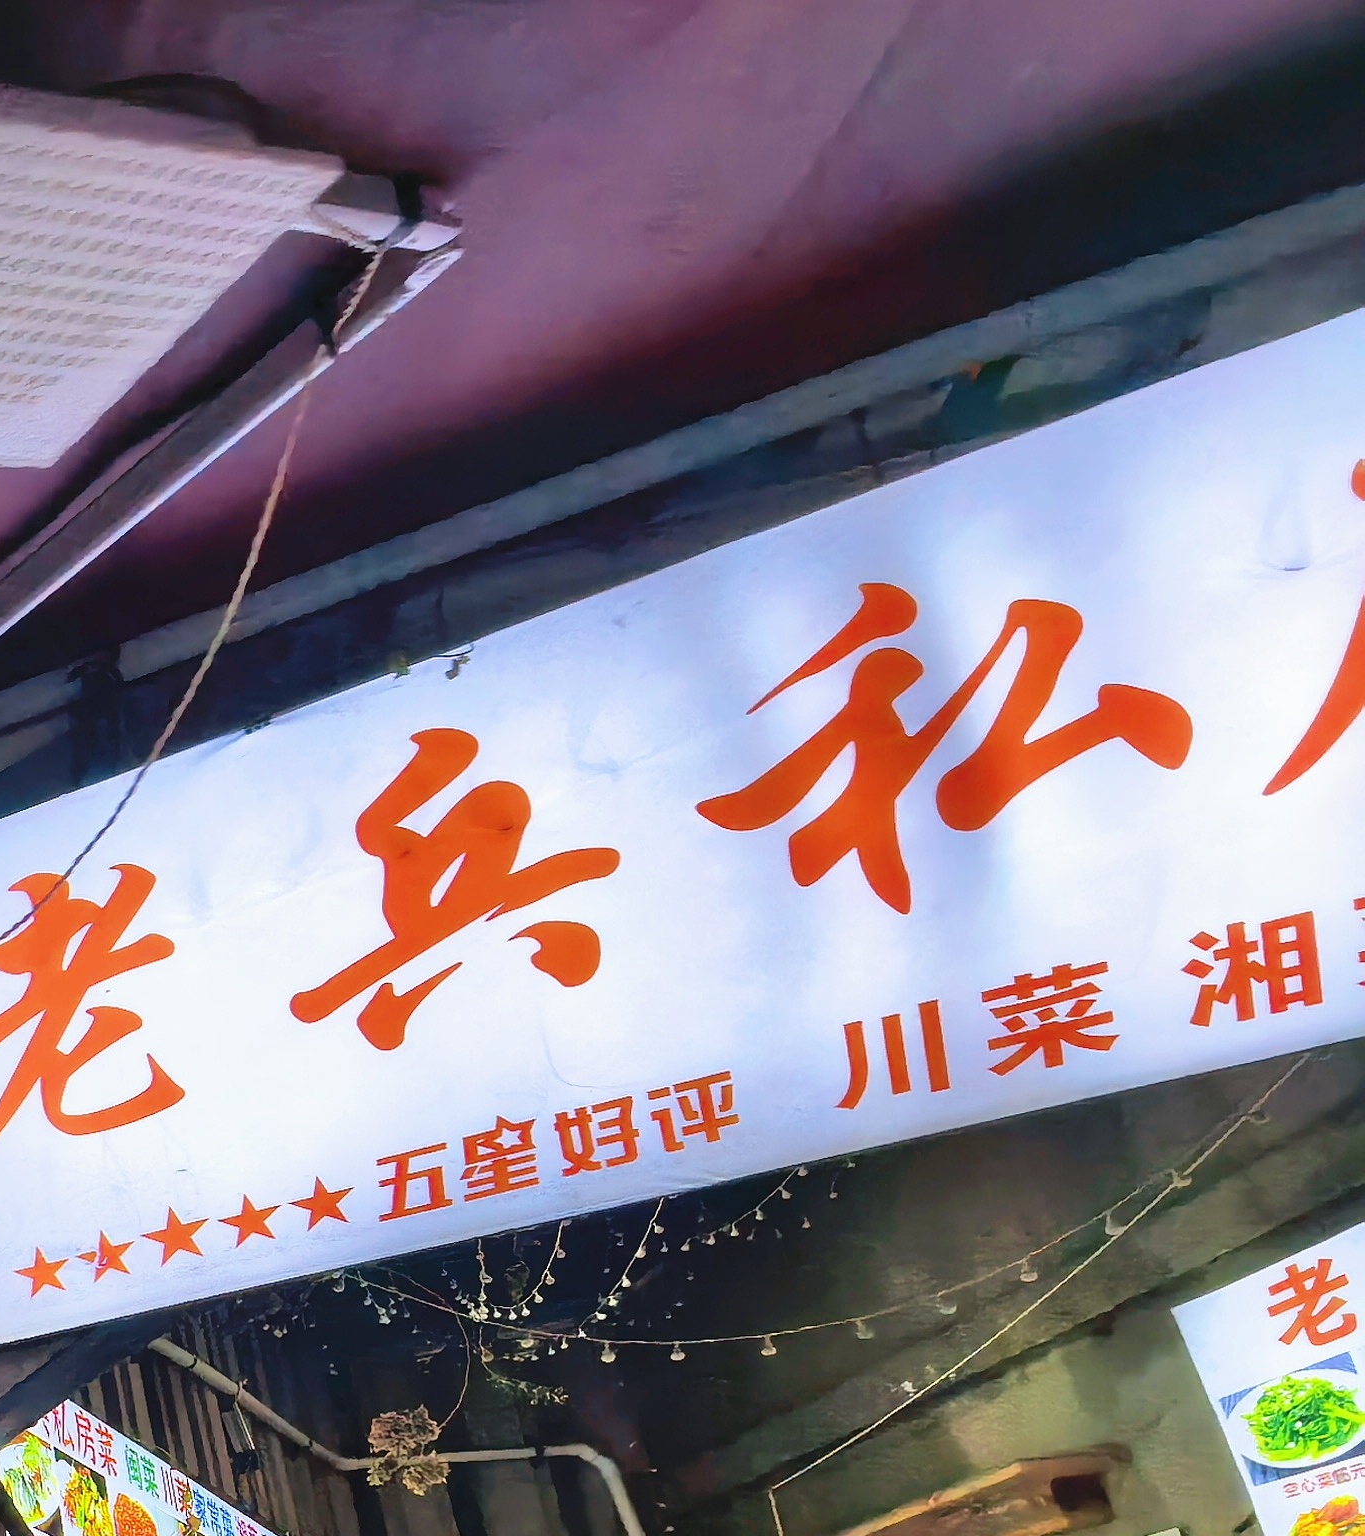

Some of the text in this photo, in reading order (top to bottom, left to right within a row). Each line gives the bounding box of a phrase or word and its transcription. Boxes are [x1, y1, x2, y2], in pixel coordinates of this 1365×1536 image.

[375, 895, 1365, 1223] 五星好评 川菜 湘
[1267, 1258, 1358, 1347] 老
[42, 1402, 118, 1477] 私房菜
